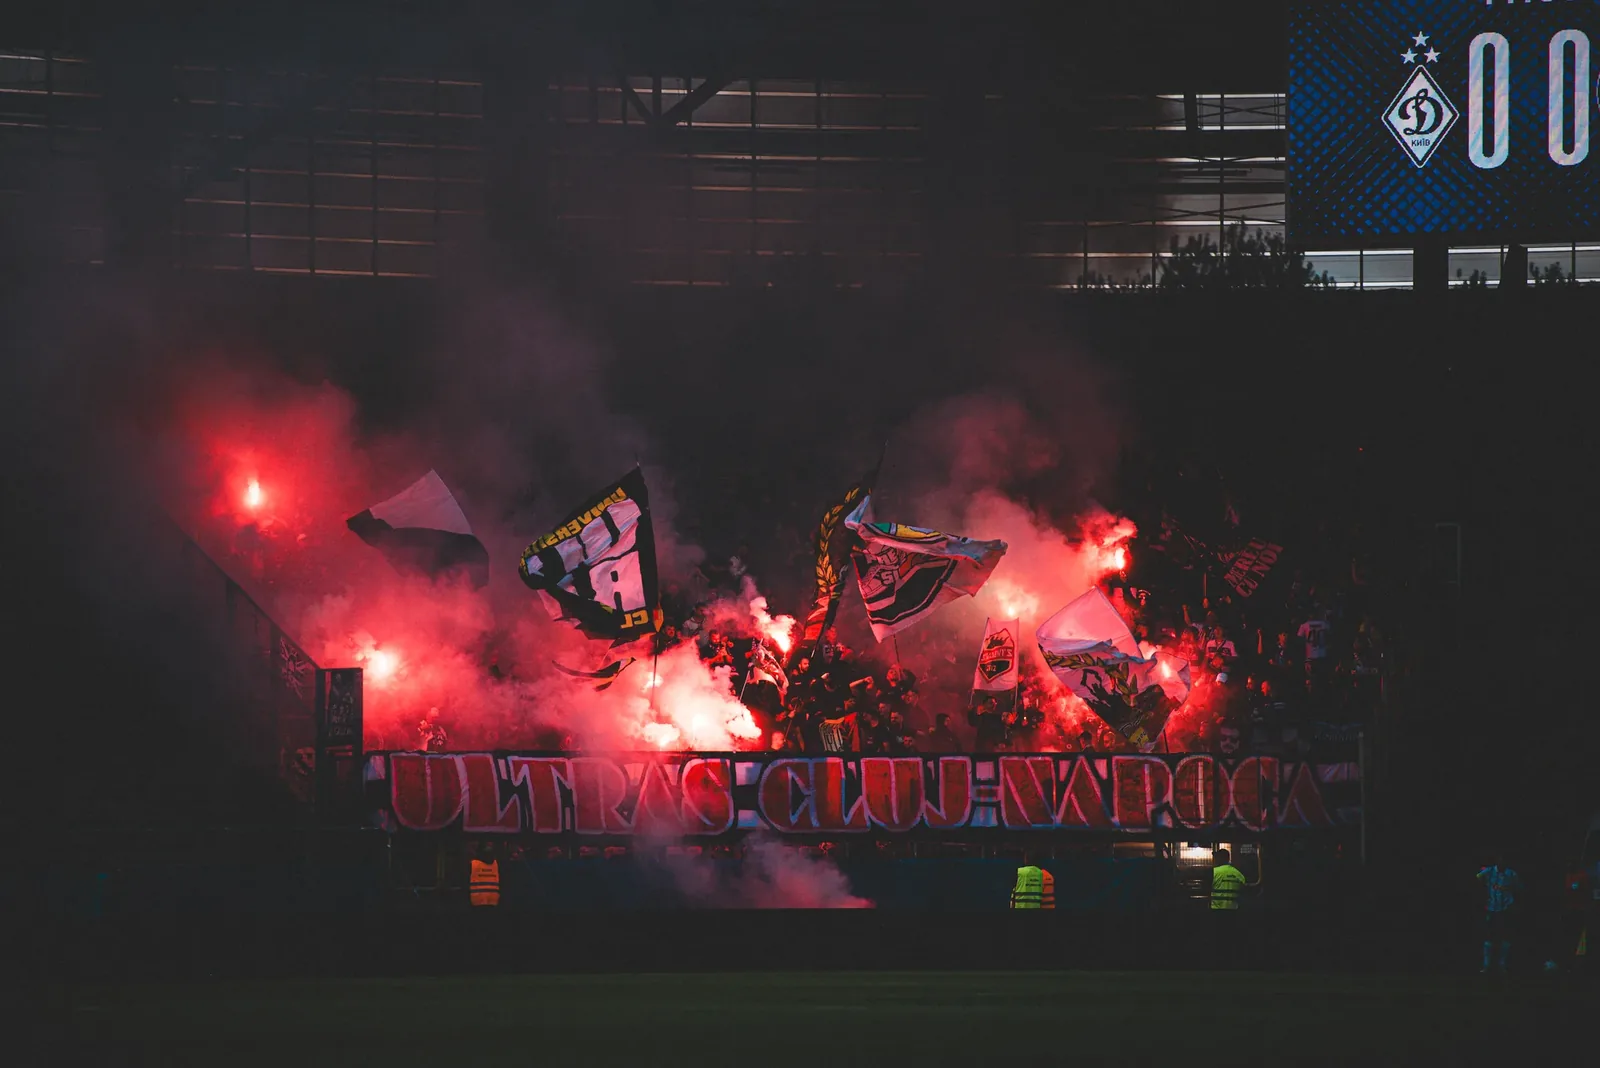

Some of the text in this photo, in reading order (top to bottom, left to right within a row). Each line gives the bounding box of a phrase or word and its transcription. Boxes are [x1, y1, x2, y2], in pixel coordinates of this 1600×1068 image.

[1469, 29, 1590, 169] 0 0
[391, 753, 735, 836] ULTRAS
